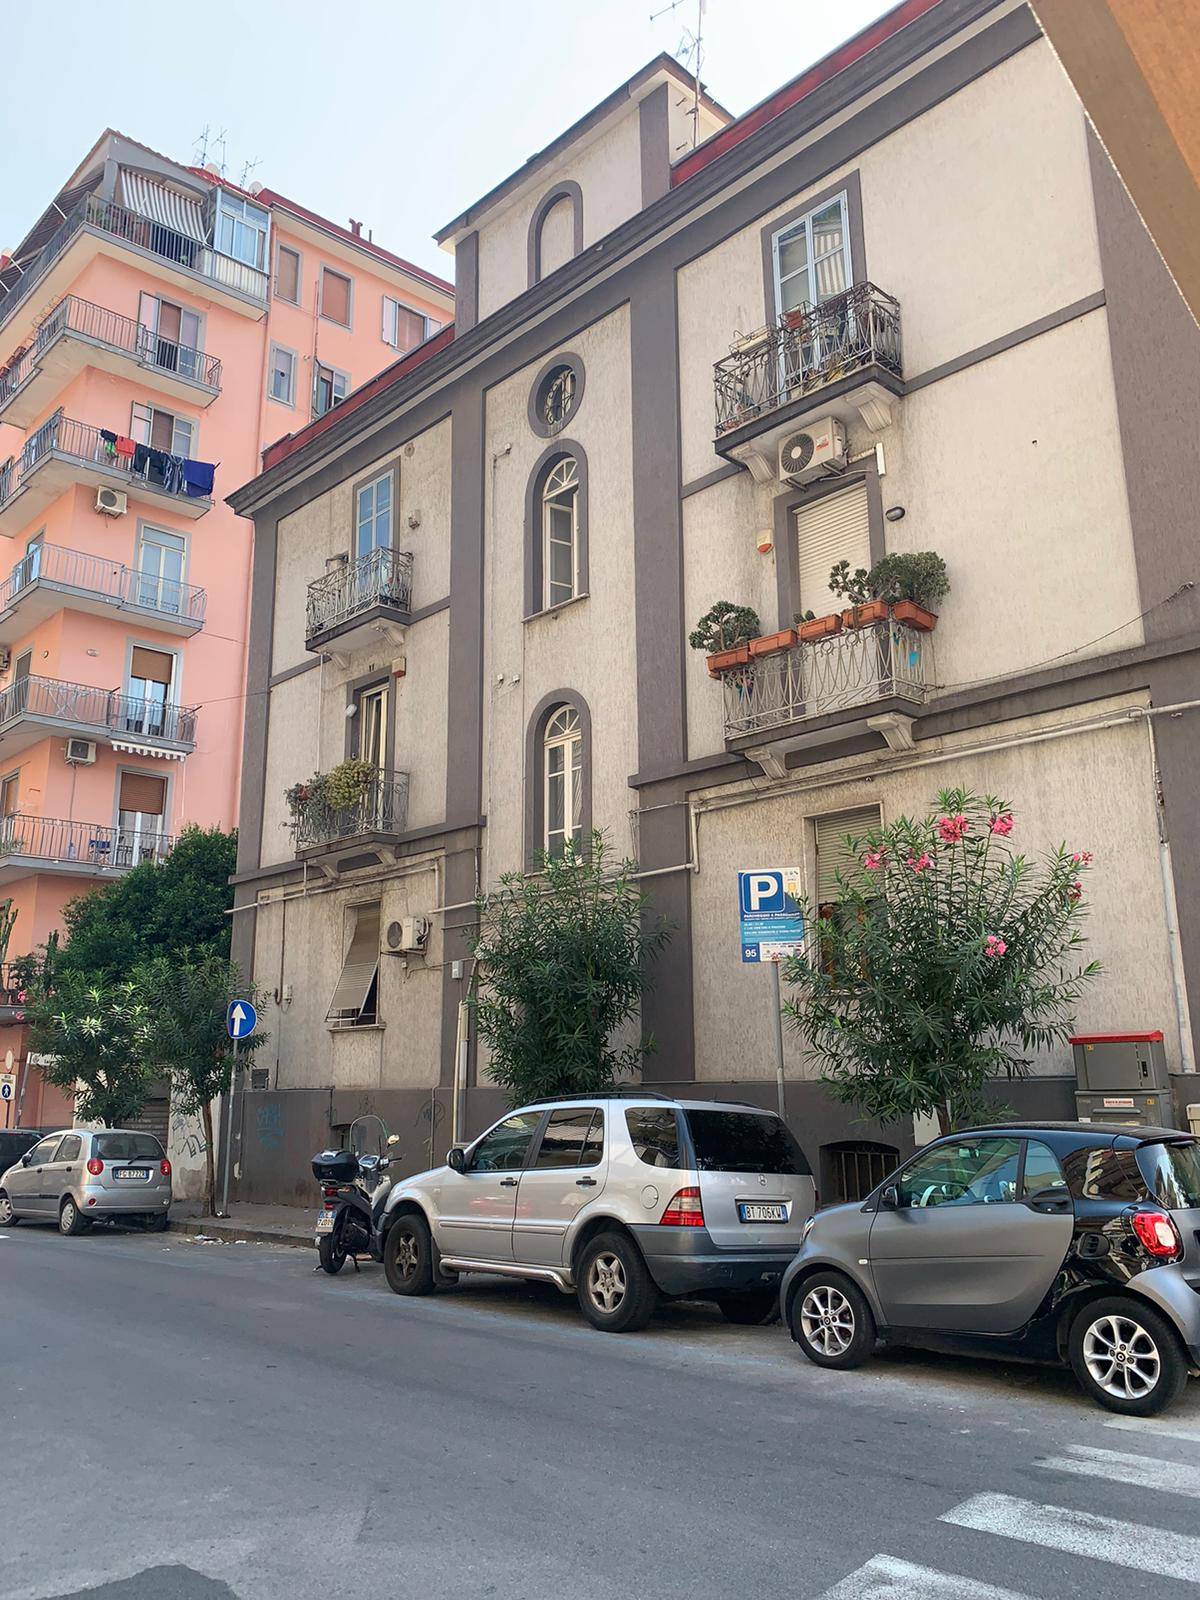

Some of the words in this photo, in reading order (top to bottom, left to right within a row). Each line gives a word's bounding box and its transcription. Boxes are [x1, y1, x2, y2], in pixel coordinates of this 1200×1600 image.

[750, 875, 778, 910] P
[745, 949, 757, 958] 95
[746, 1206, 756, 1218] BT
